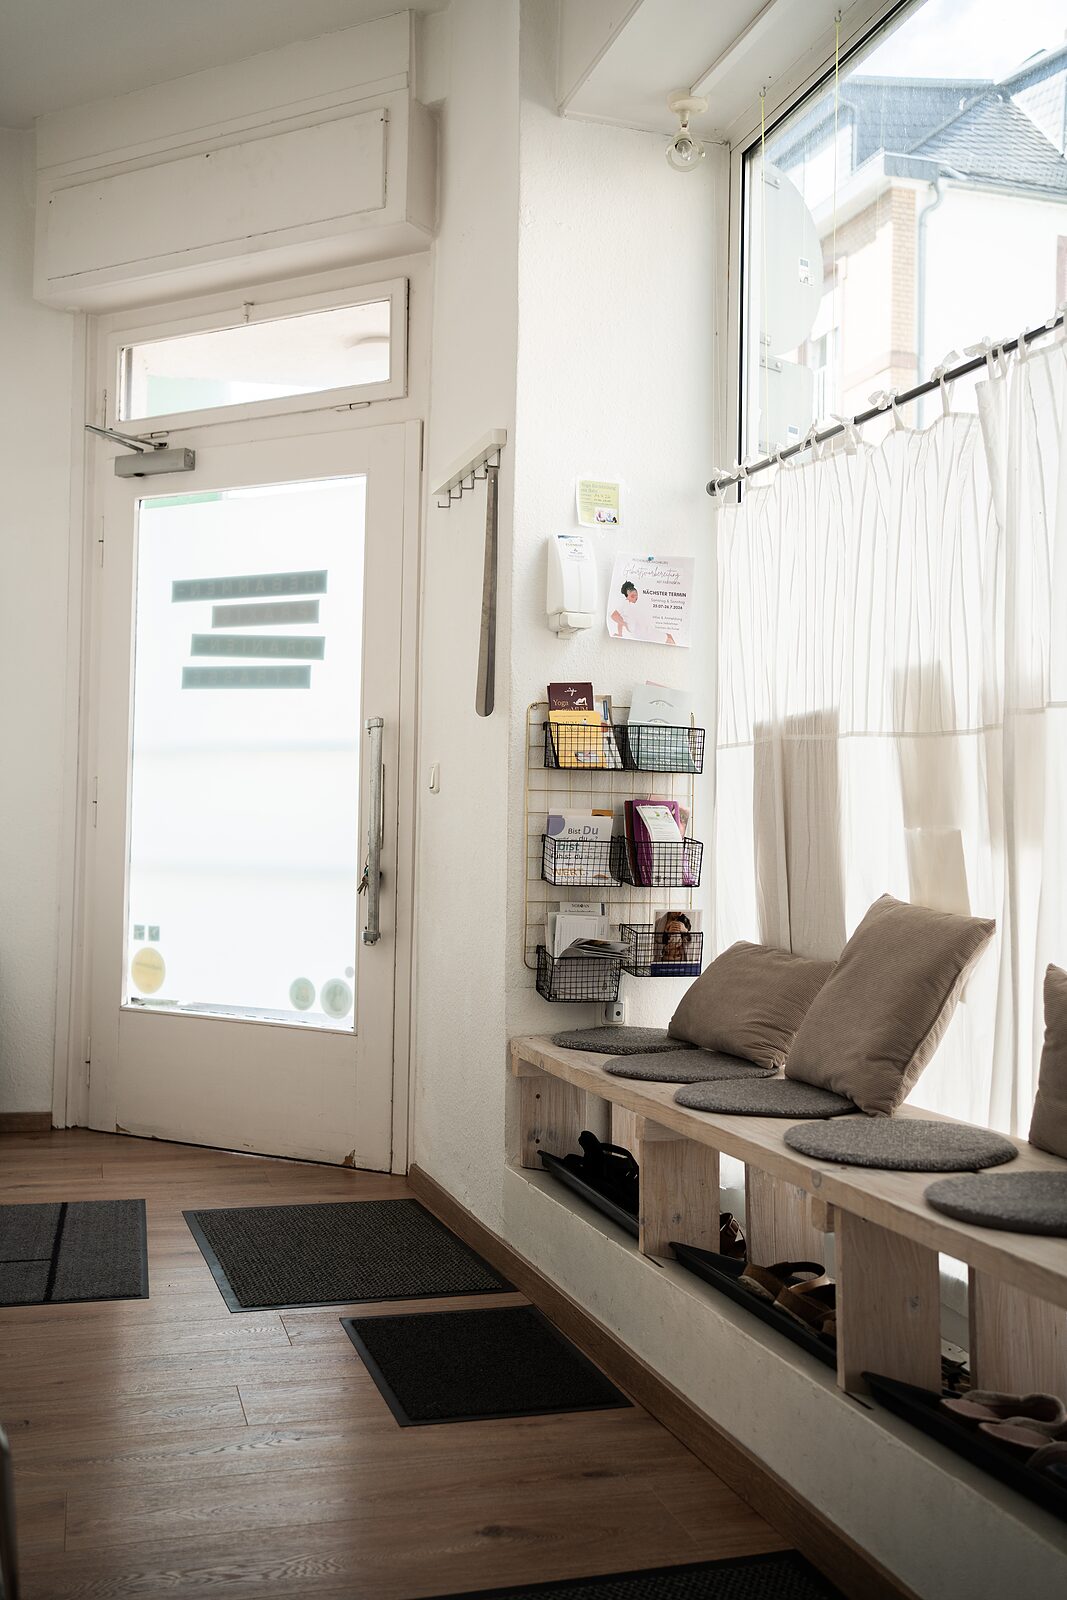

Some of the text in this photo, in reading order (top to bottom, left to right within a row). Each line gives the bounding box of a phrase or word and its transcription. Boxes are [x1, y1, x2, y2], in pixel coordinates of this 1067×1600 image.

[643, 588, 667, 597] NÄCHSTER
[553, 699, 569, 708] Yoga
[582, 825, 599, 835] Du
